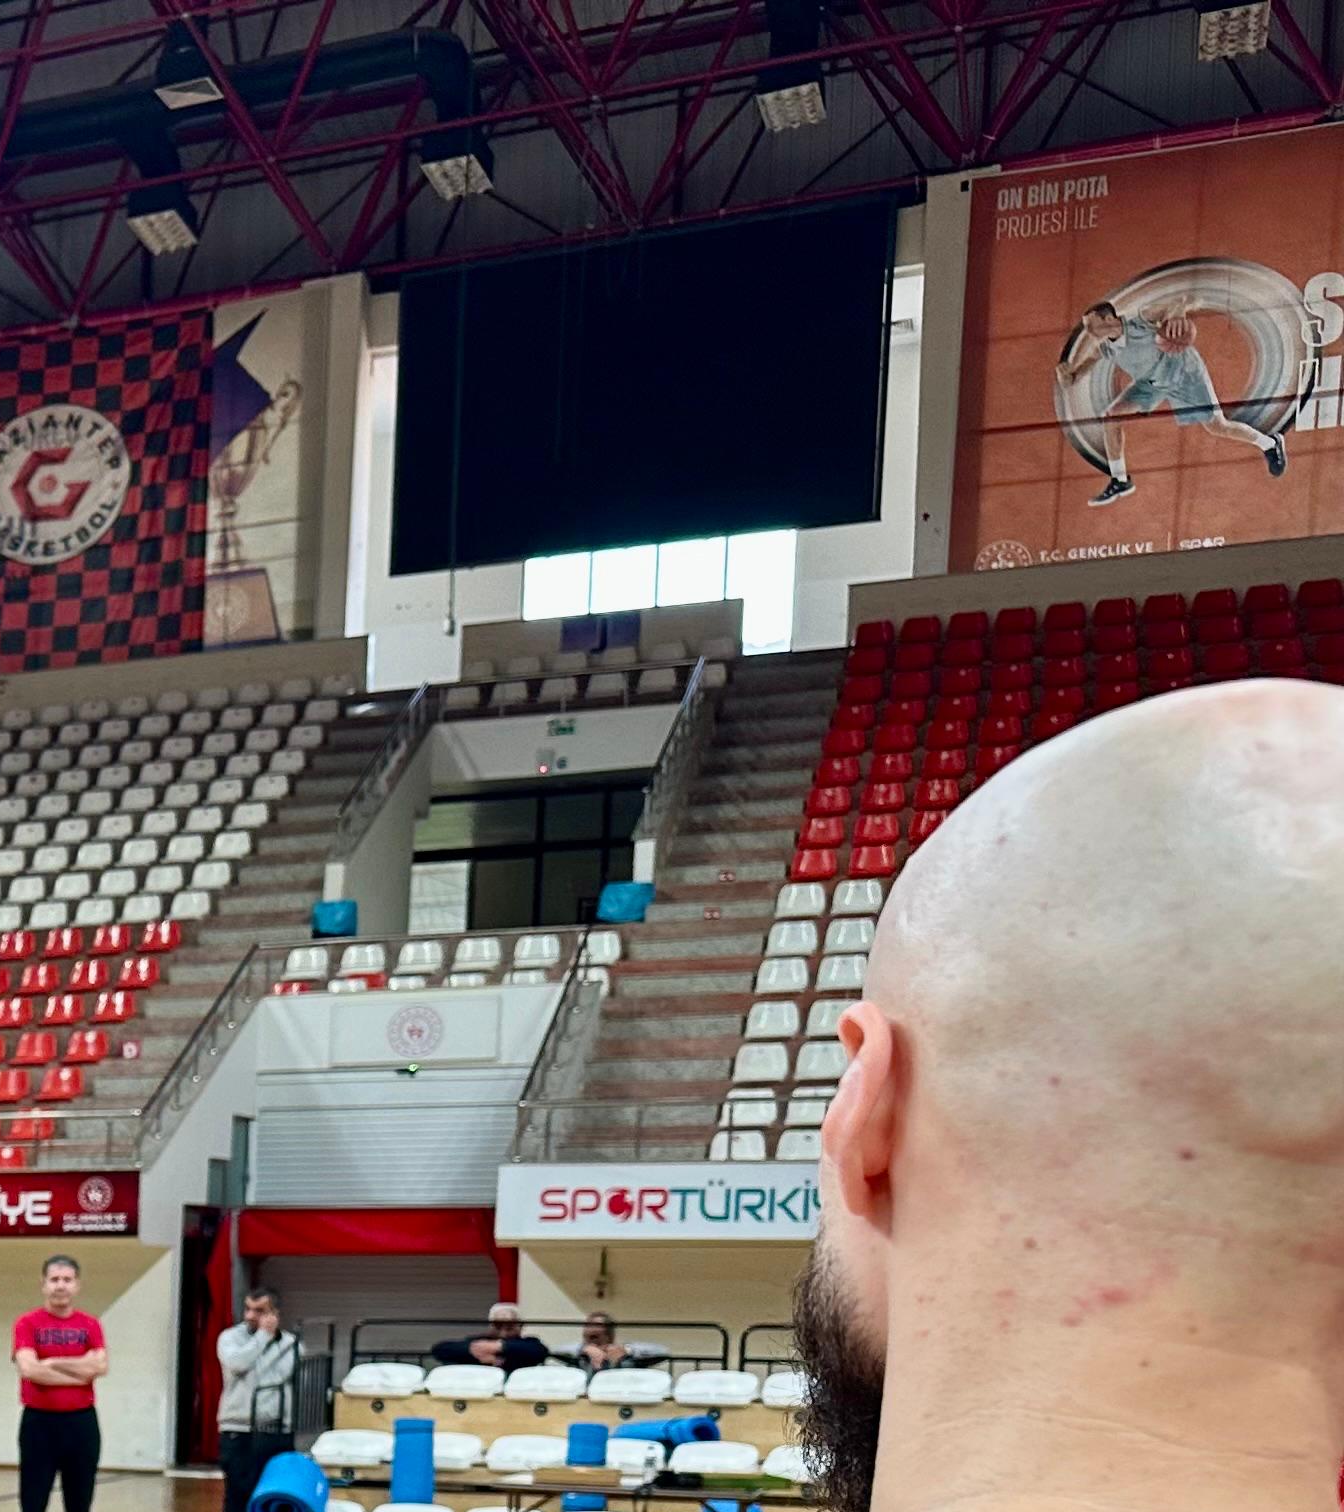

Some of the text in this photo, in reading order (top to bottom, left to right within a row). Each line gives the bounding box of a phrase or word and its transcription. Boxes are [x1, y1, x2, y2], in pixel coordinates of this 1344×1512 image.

[997, 175, 1109, 211] ON BİN POTA
[538, 1178, 822, 1224] SPORTÜRKİ
